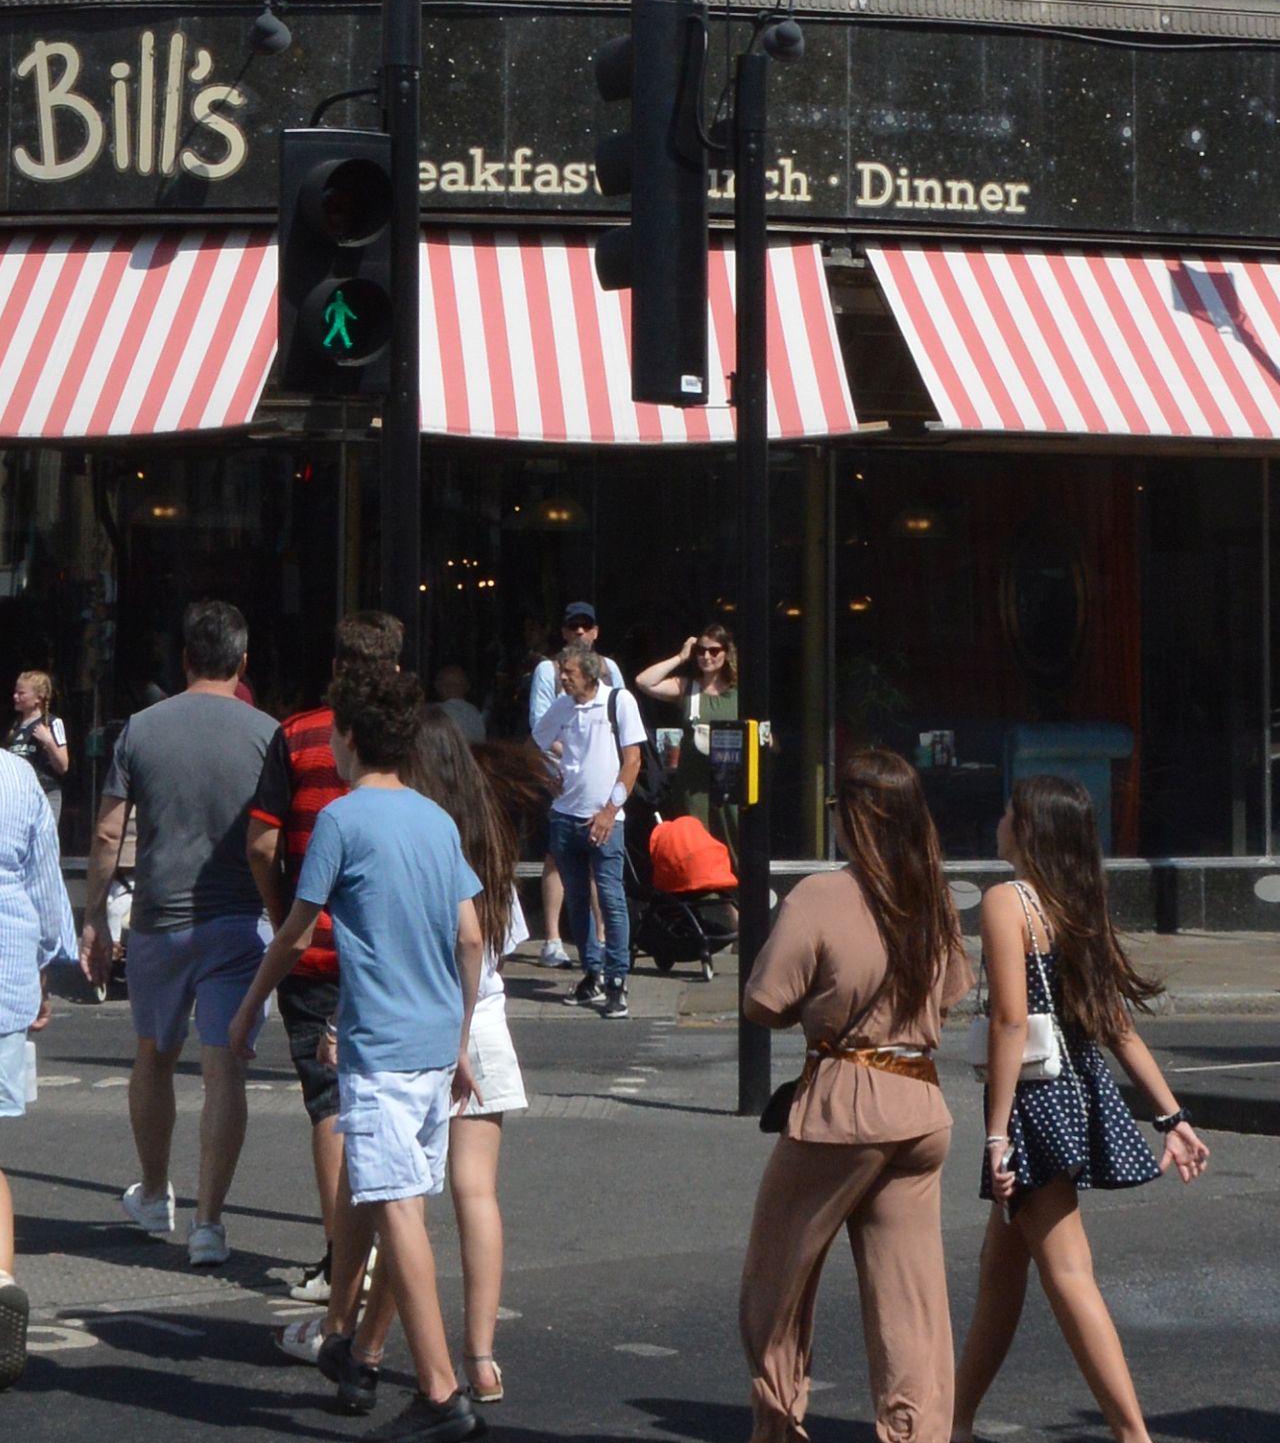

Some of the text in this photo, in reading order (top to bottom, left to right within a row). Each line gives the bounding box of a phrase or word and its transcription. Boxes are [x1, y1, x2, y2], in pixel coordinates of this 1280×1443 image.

[13, 30, 247, 180] Bill's
[418, 148, 603, 196] eakfas
[855, 161, 1031, 214] Dinner
